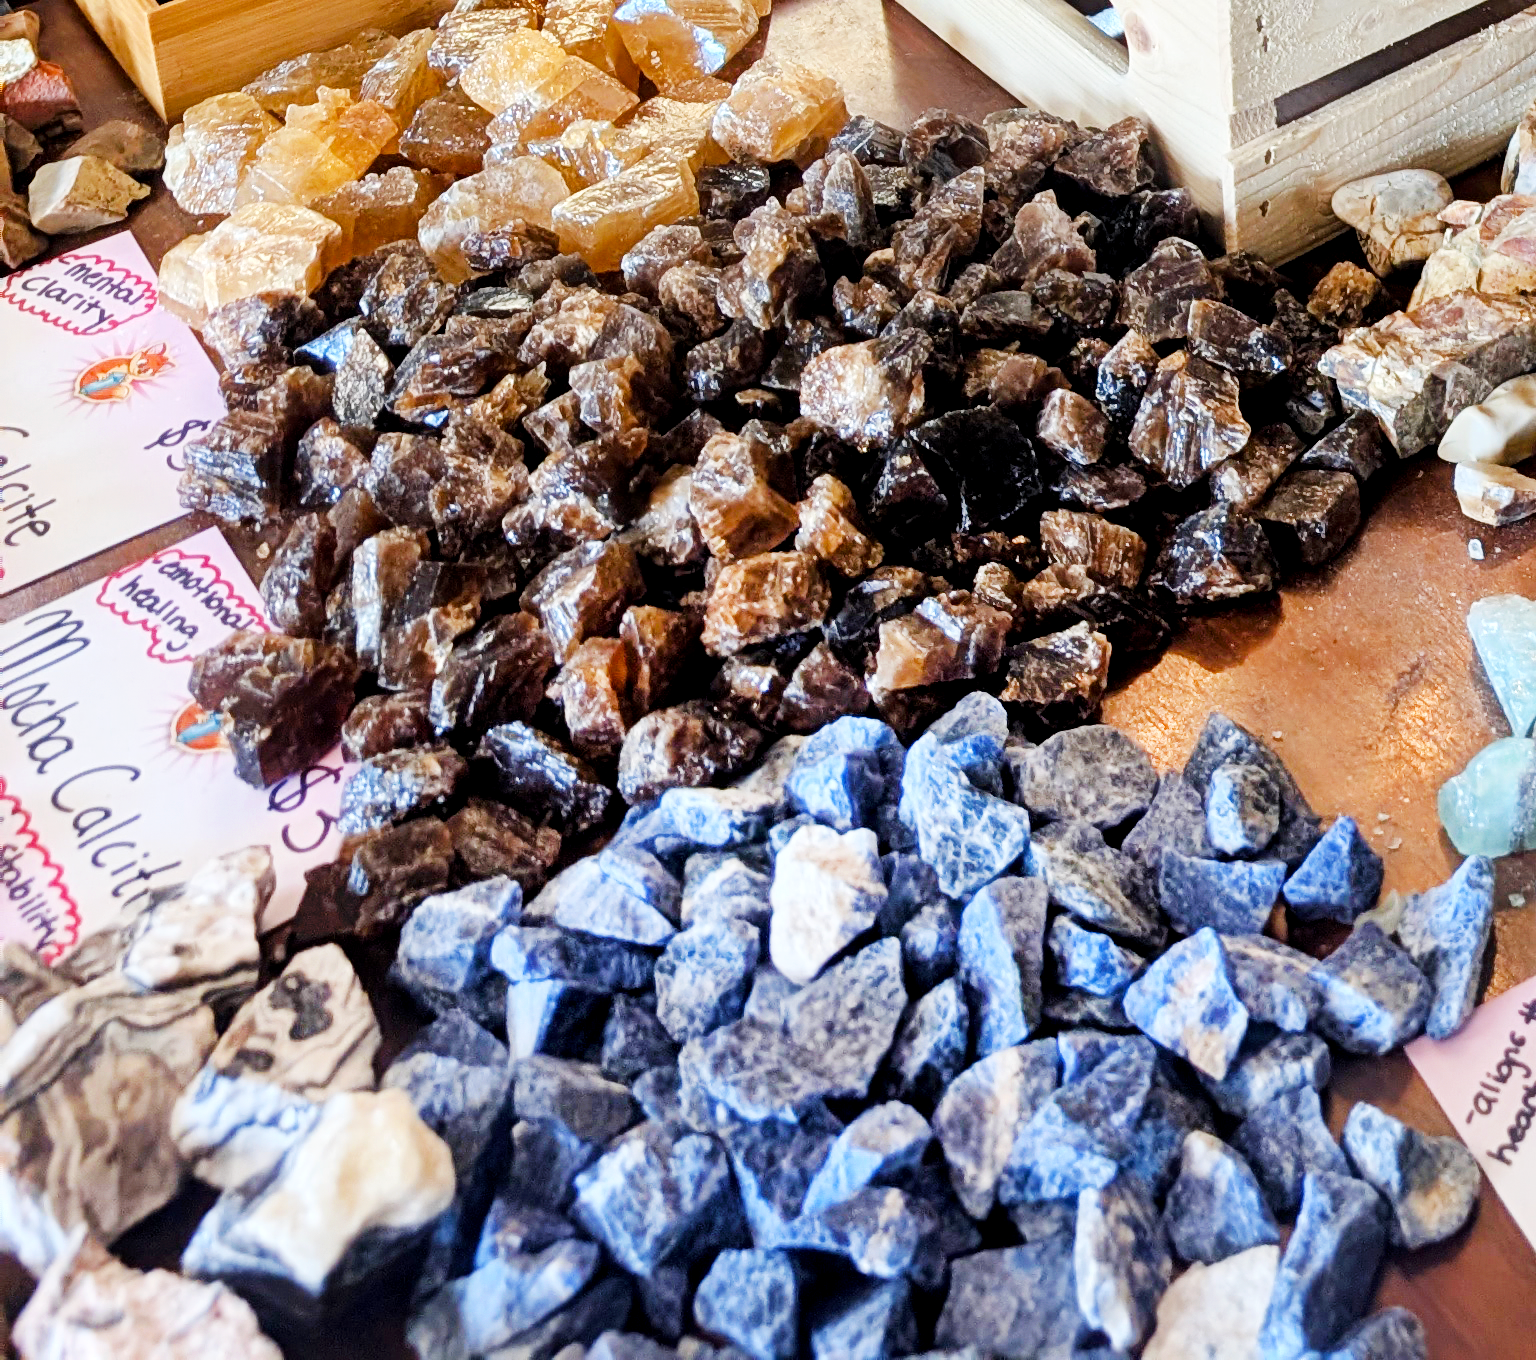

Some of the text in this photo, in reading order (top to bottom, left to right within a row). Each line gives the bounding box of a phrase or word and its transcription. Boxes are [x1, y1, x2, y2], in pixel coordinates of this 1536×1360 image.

[21, 275, 115, 334] Clarity
[119, 574, 199, 653] healing
[0, 609, 183, 908] Mocha Calcit
